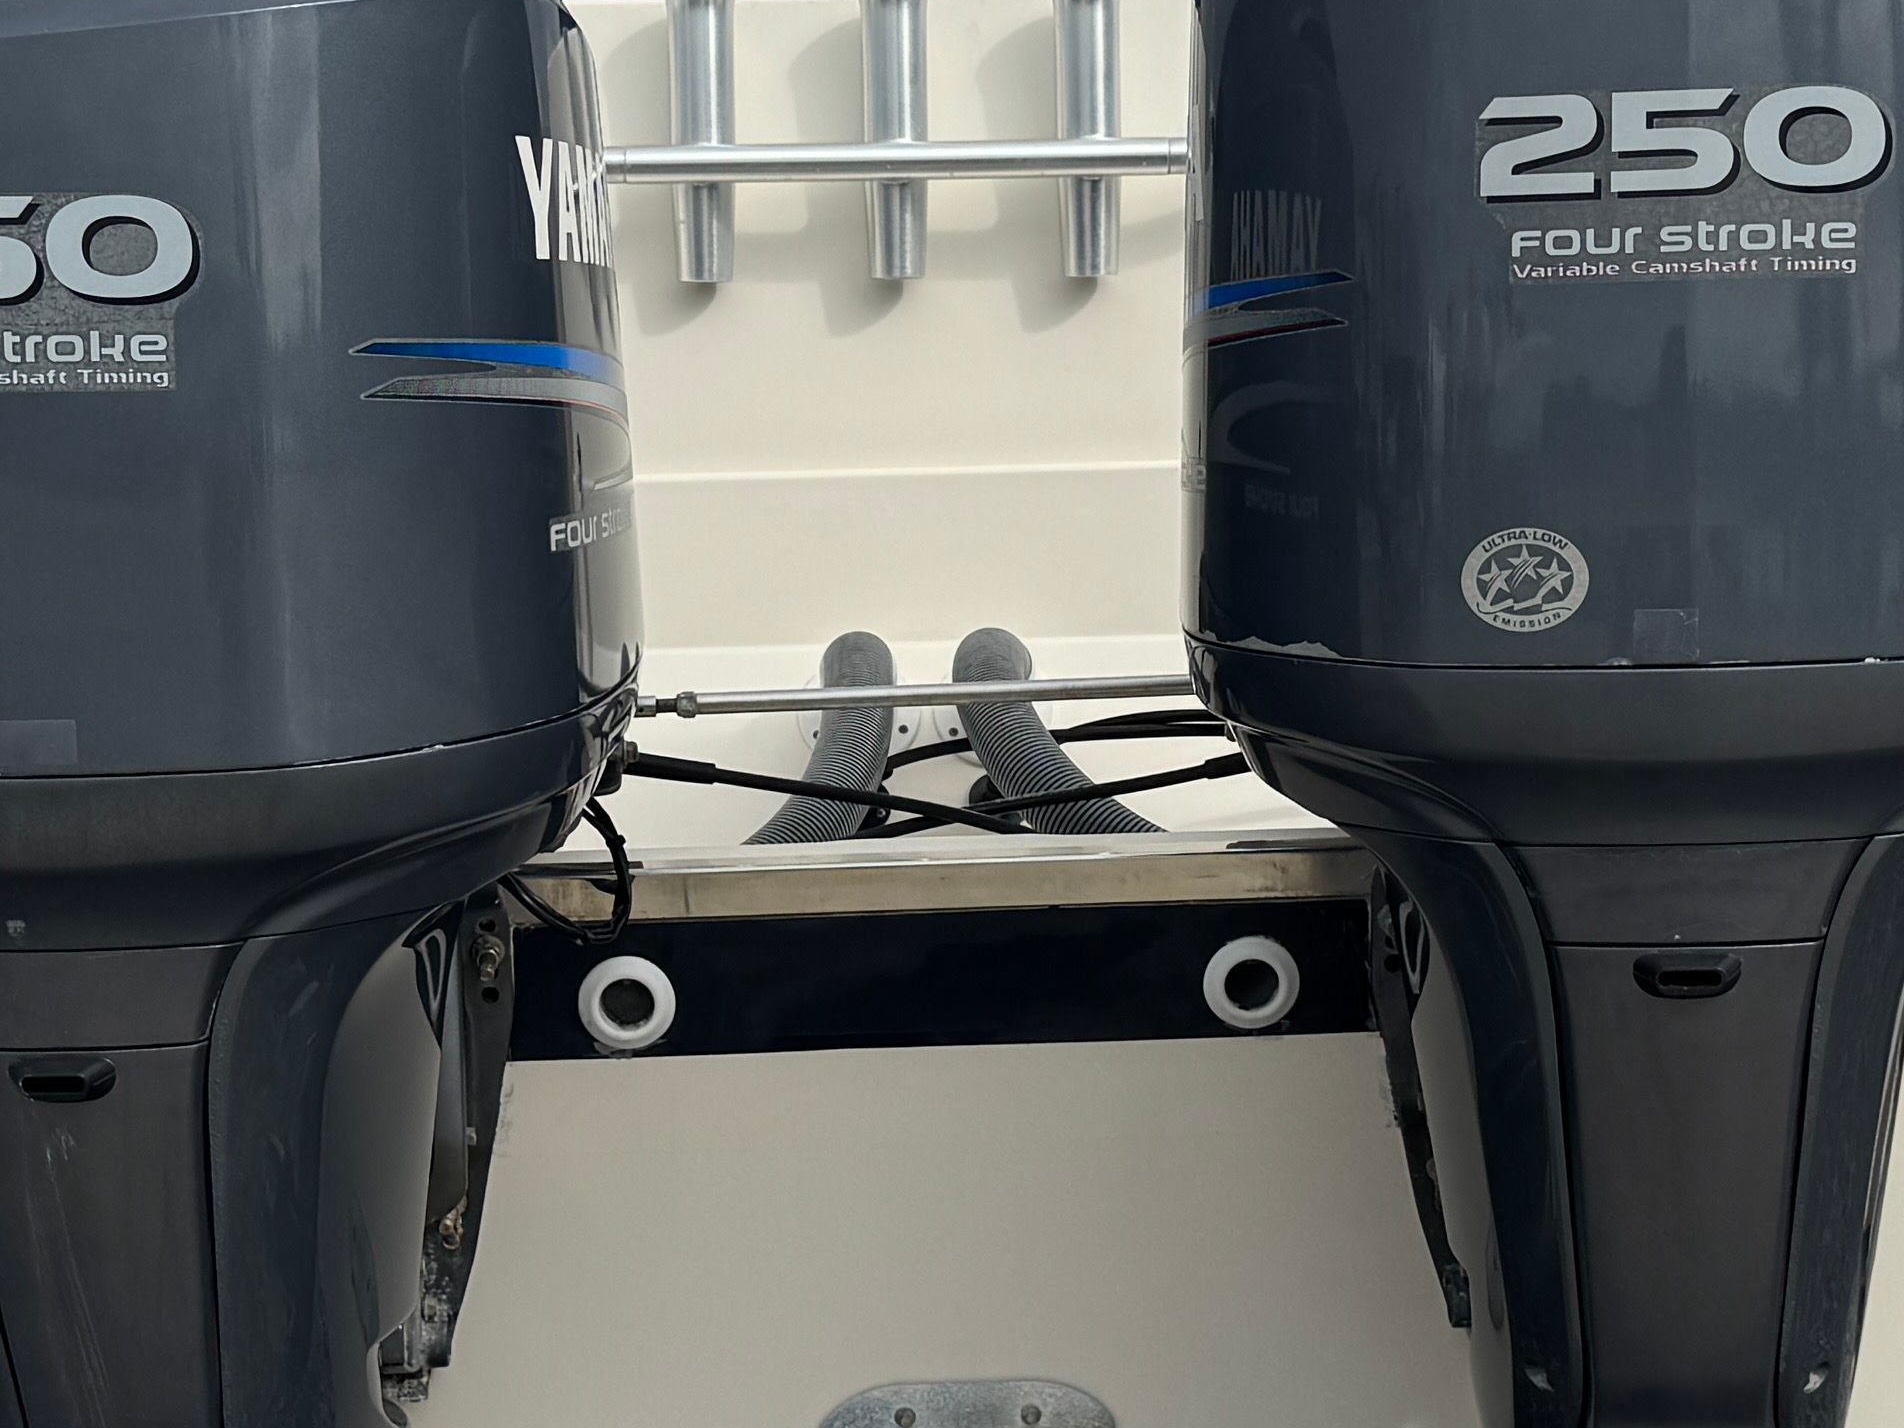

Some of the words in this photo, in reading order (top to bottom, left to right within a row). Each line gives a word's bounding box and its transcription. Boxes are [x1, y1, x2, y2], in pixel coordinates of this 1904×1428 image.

[1478, 85, 1893, 204] 250
[514, 134, 613, 269] YAMA
[1512, 262, 1620, 279] Variable
[1631, 257, 1757, 275] Camshaft
[1770, 256, 1857, 274] Timing
[78, 369, 170, 388] Timing
[1492, 611, 1562, 628] EMISSION
